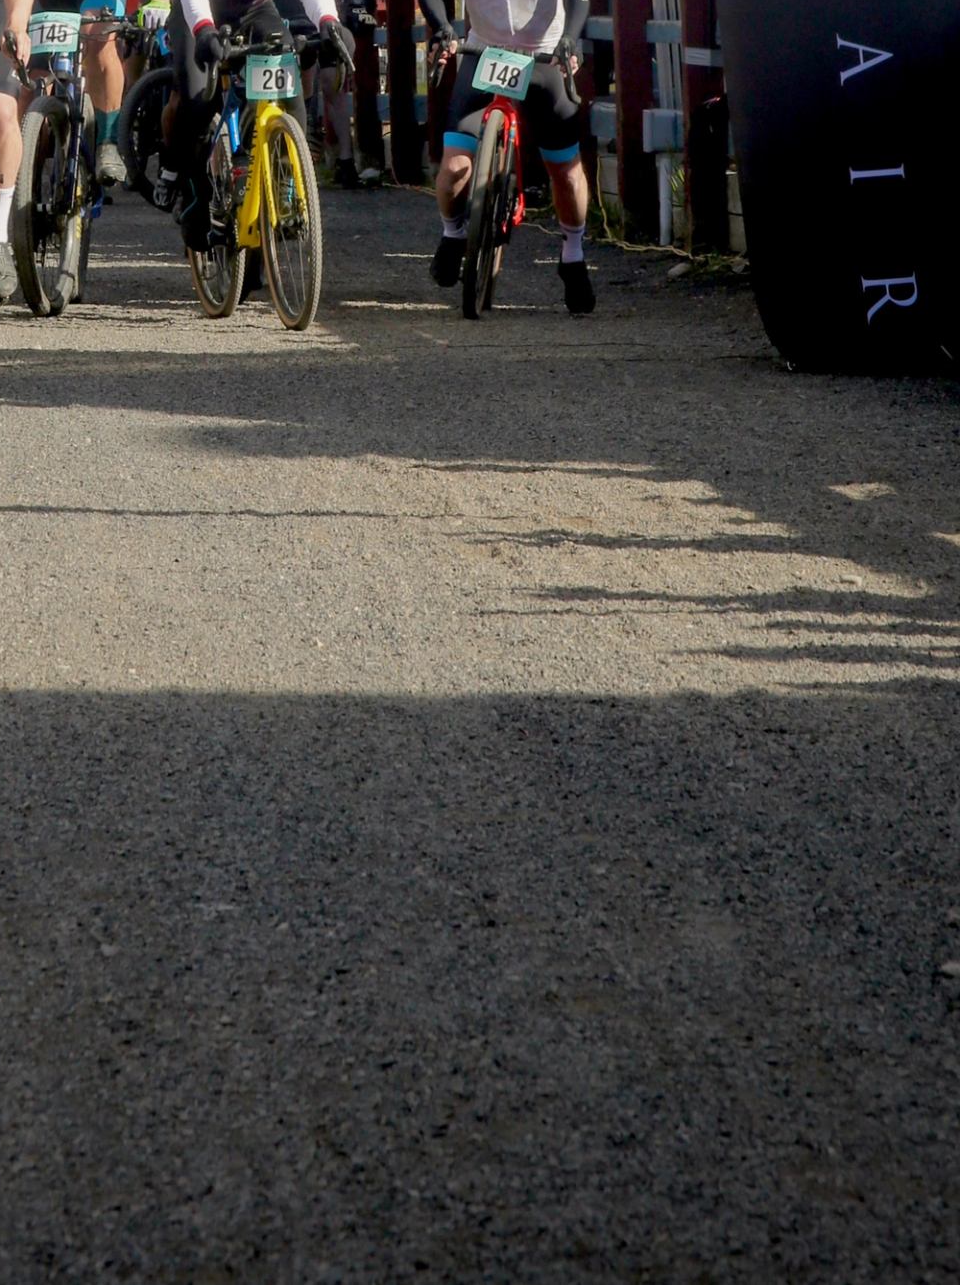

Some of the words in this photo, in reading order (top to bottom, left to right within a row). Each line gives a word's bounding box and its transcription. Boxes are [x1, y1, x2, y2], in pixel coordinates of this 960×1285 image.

[40, 24, 67, 44] 145
[263, 69, 285, 90] 26
[489, 62, 521, 88] 148
